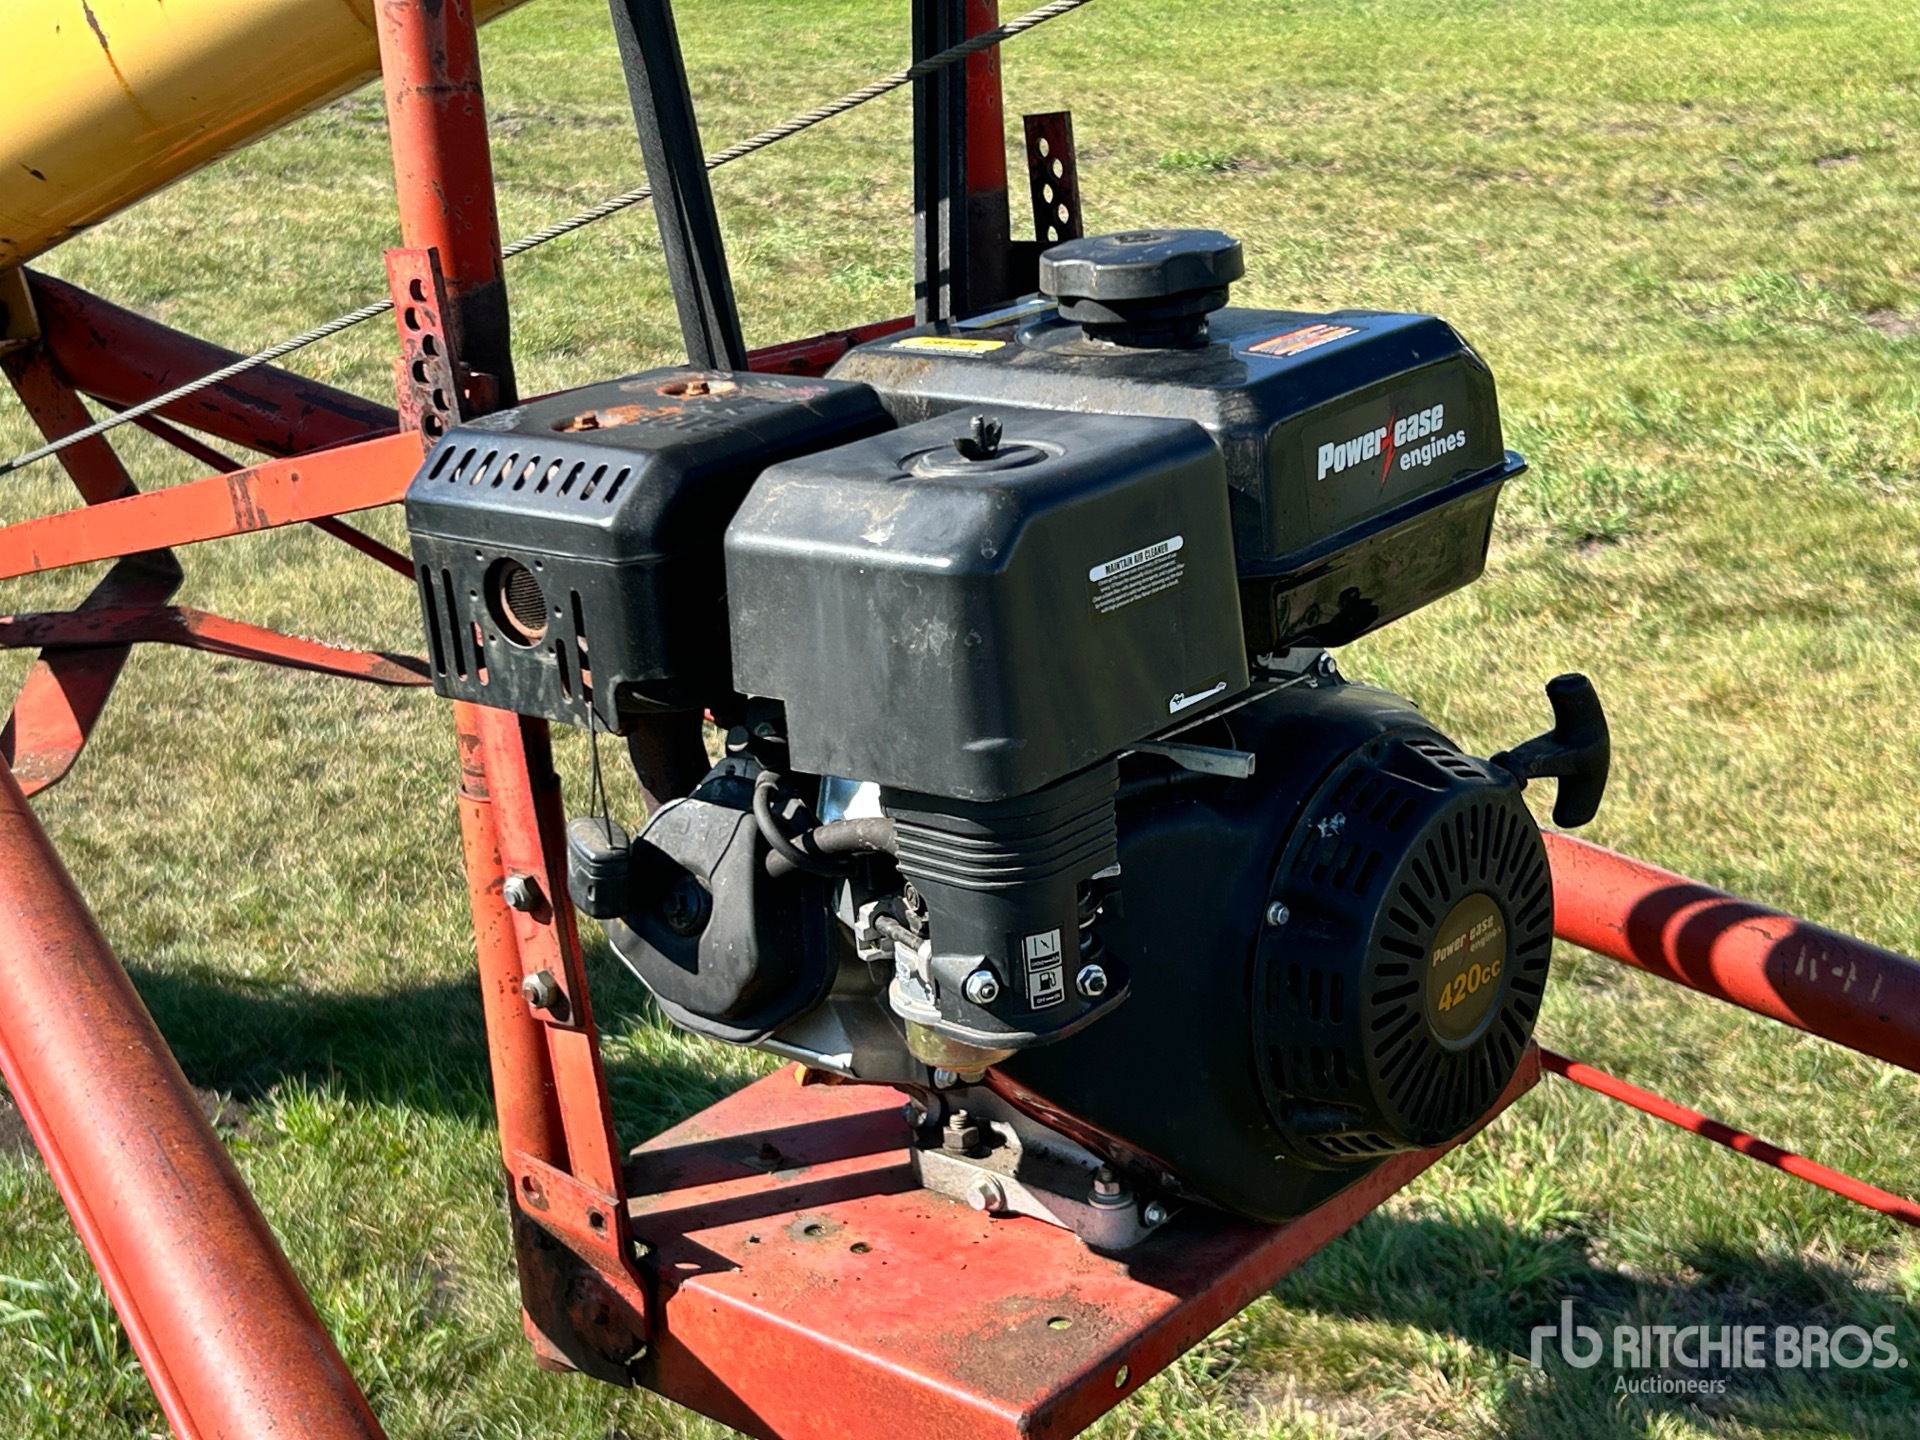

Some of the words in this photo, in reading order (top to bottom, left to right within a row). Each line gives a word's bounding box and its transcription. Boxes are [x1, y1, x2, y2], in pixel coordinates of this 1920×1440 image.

[1400, 430, 1466, 471] engines
[1144, 542, 1169, 560] CLEANER
[1470, 925, 1502, 952] engines
[1438, 960, 1501, 1011] 420cc
